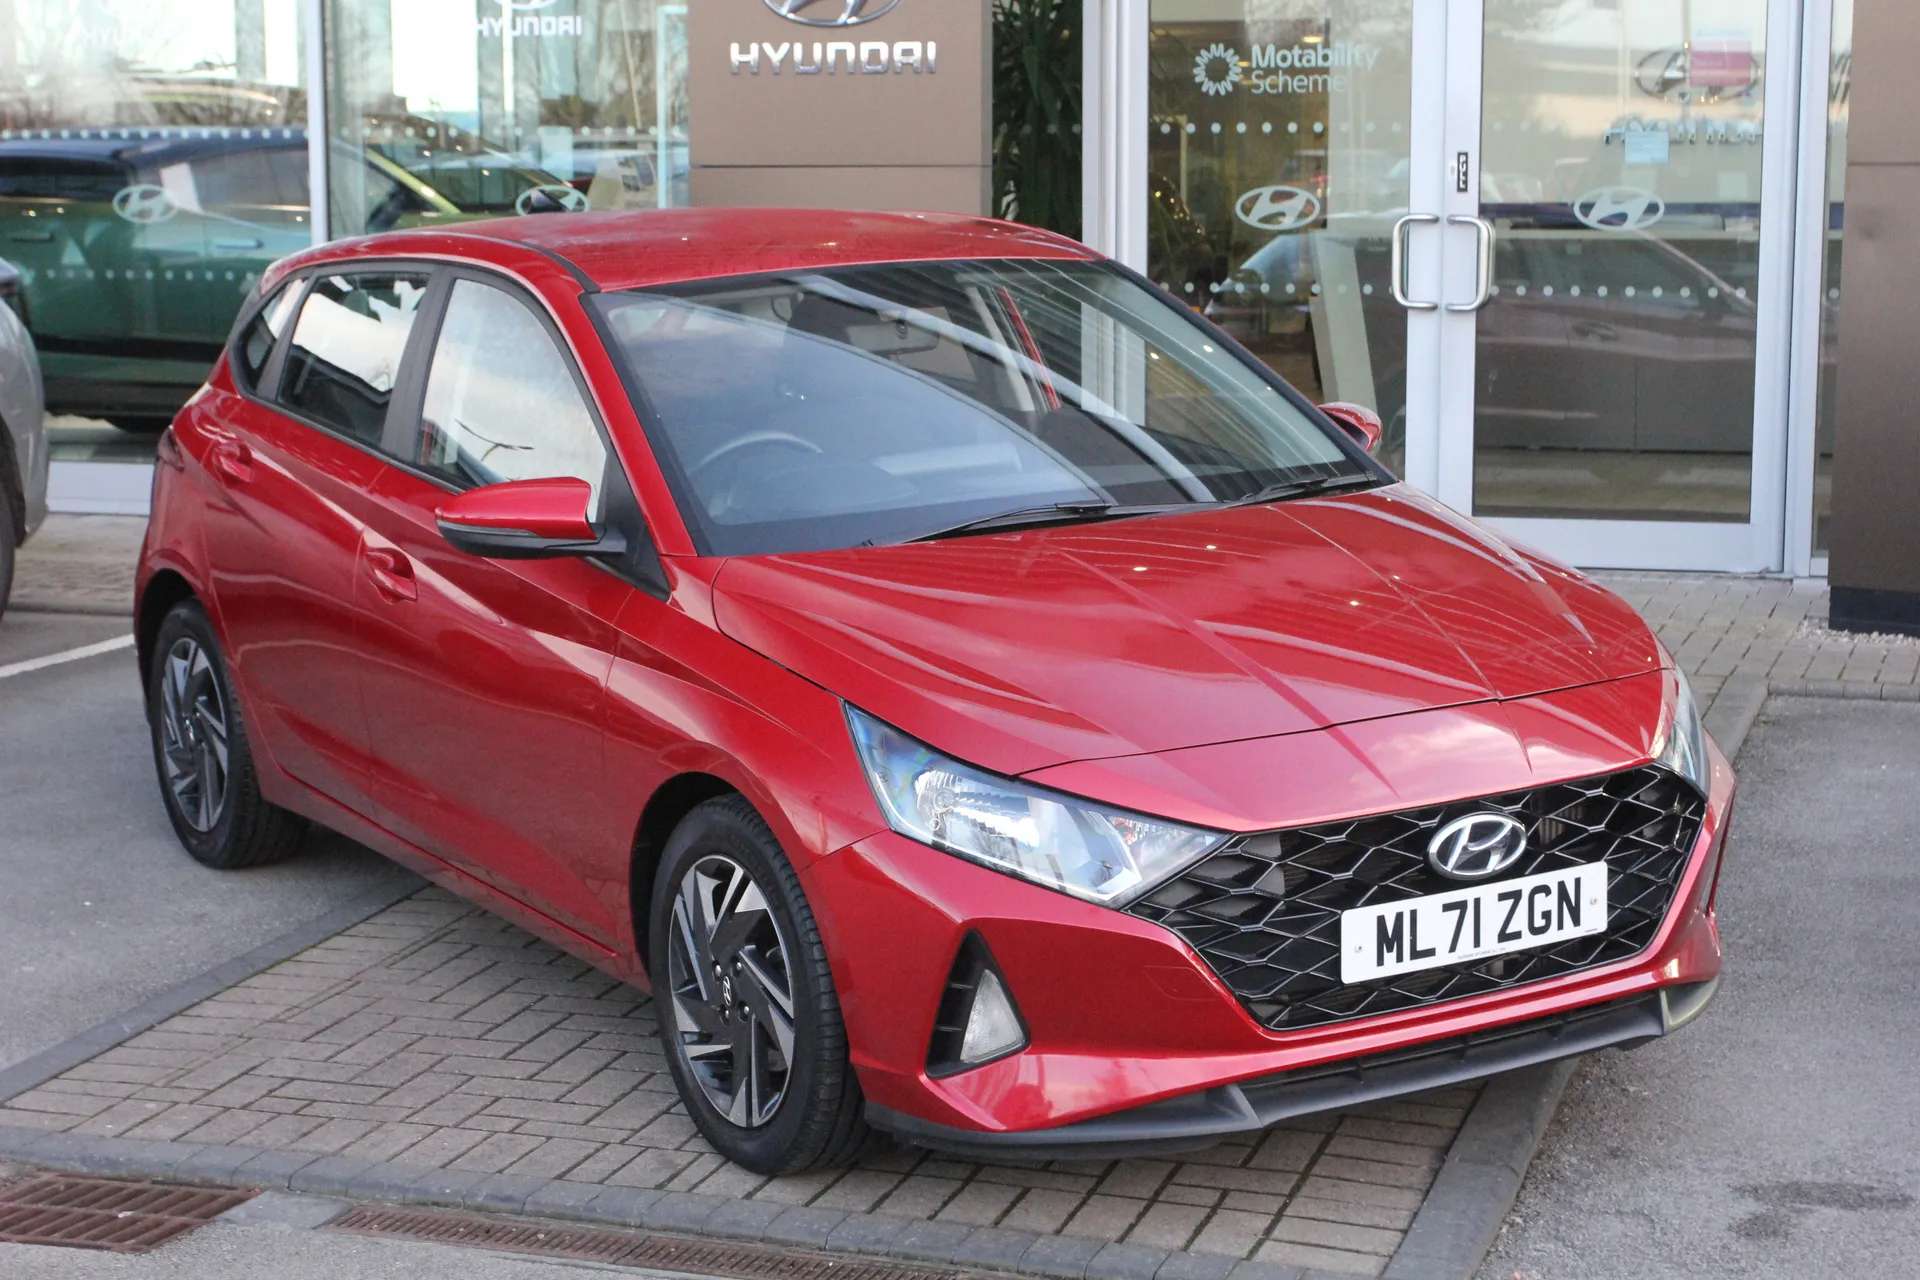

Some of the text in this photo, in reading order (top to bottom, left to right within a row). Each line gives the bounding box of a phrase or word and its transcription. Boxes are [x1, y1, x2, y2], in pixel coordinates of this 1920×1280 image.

[473, 15, 582, 38] HYUNDAI
[730, 41, 937, 75] HYUNDAI
[1251, 43, 1379, 69] Motability
[1250, 69, 1346, 94] Scheme
[1376, 876, 1581, 967] ML71 ZGN
